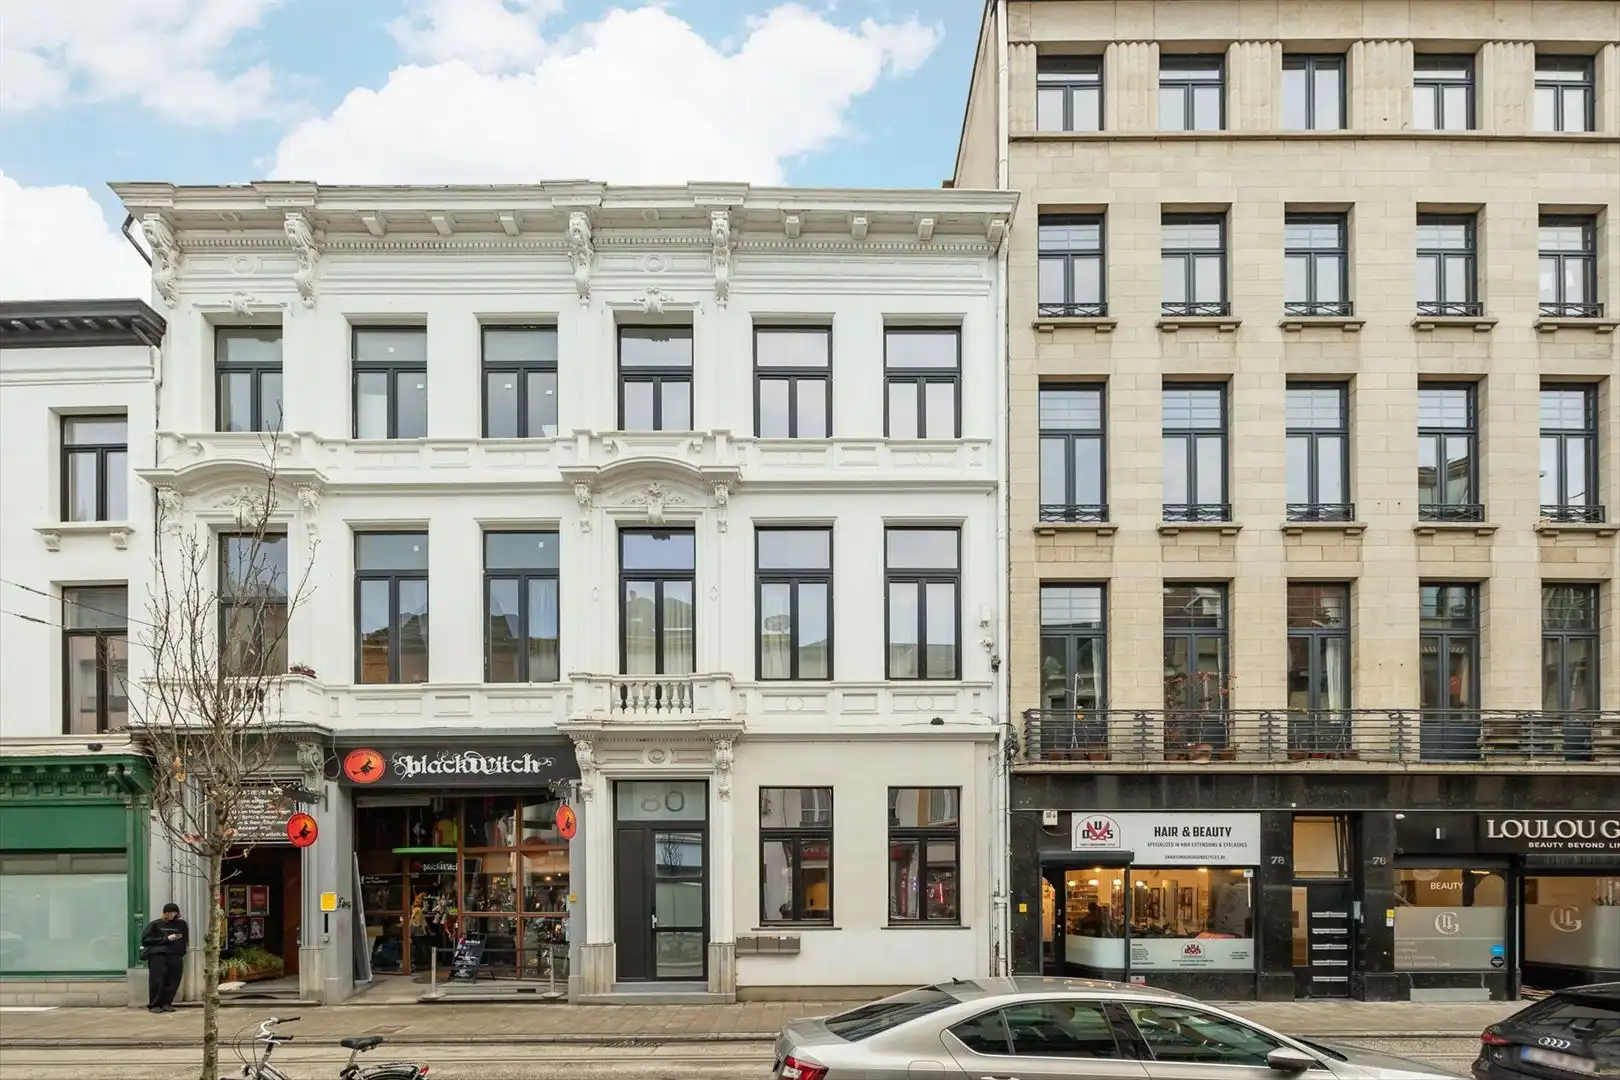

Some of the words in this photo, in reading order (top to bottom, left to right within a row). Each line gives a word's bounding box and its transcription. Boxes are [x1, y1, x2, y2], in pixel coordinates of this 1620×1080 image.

[641, 790, 685, 812] 80
[1154, 826, 1178, 837] HAIR
[1182, 826, 1191, 837] &
[1193, 826, 1232, 837] BEAUTY
[1486, 819, 1596, 839] LOULOU
[1270, 856, 1285, 865] 78
[1372, 857, 1387, 865] 76
[1430, 882, 1464, 890] BEAUTY
